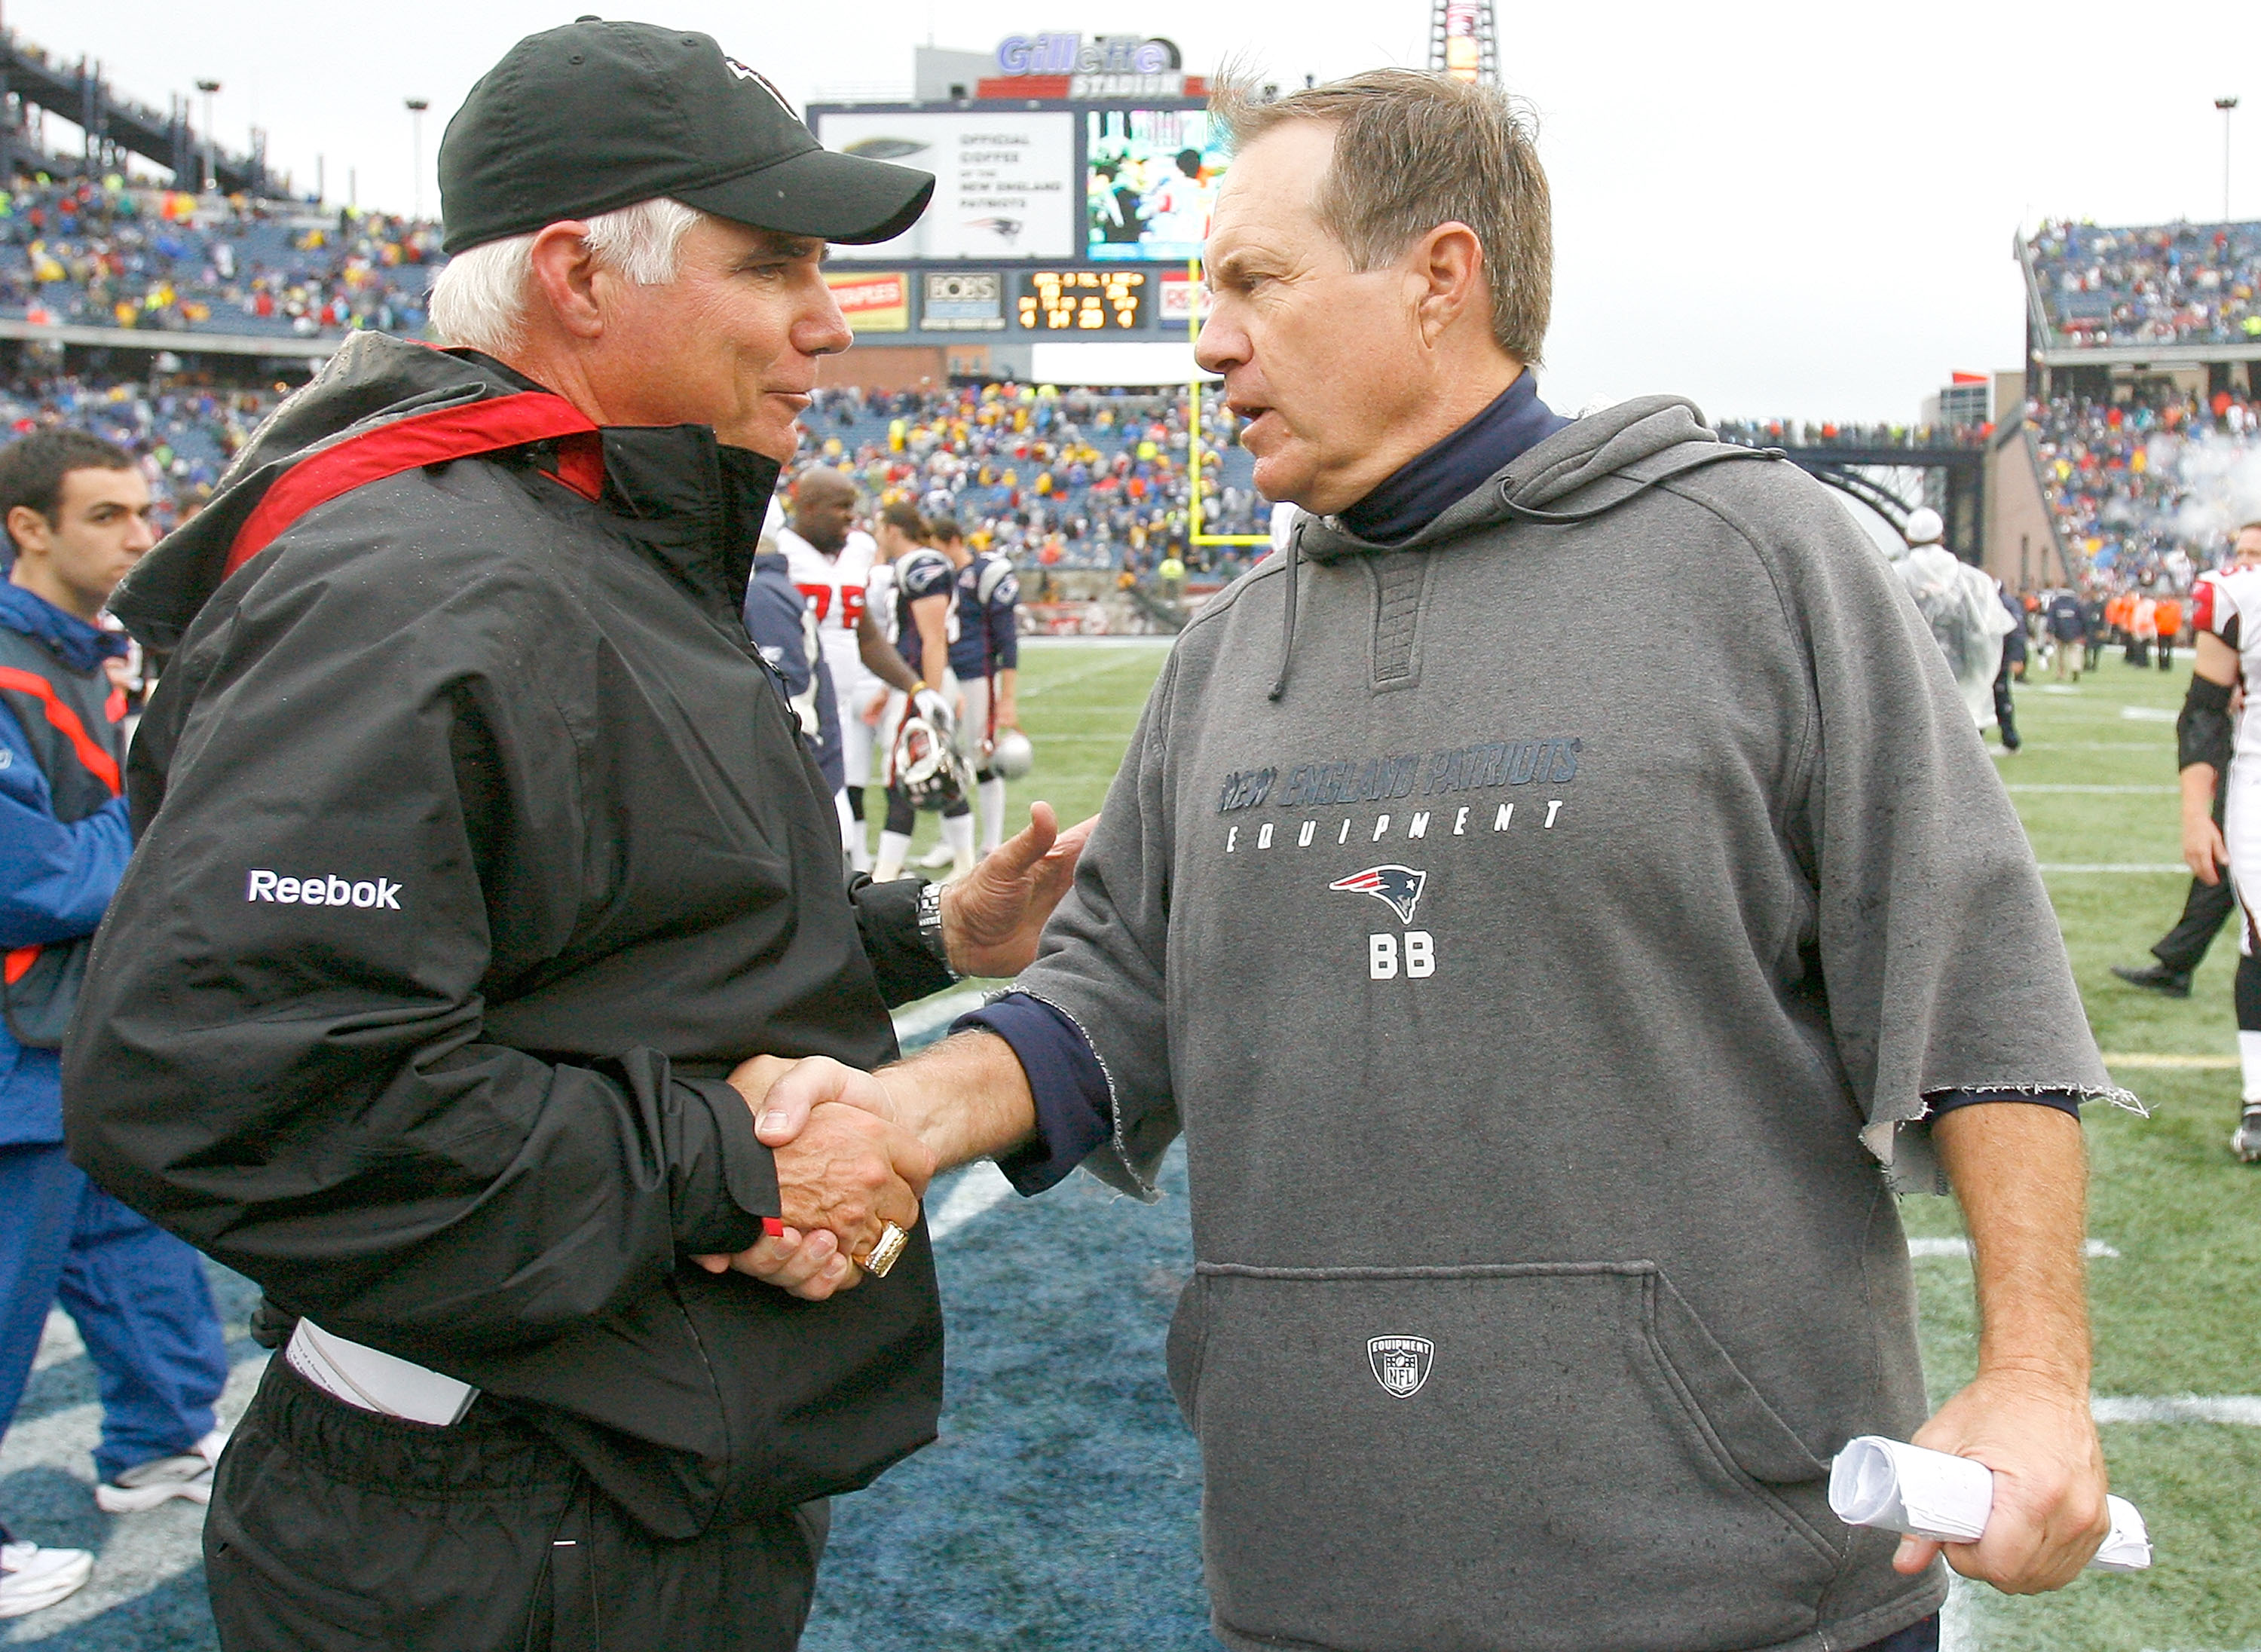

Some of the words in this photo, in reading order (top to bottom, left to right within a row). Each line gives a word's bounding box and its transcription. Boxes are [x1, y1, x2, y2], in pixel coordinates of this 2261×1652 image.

[995, 32, 1168, 75] Gillette
[1217, 766, 1279, 814] NEW
[1280, 756, 1421, 807] ENGLAND
[1423, 738, 1580, 797] PATRIOTS
[1225, 800, 1563, 853] EQUIPMENT
[247, 868, 402, 910] Reebok
[1368, 929, 1436, 980] BB
[1372, 1339, 1430, 1355] EQUIPMENT
[1388, 1368, 1415, 1387] NFL
